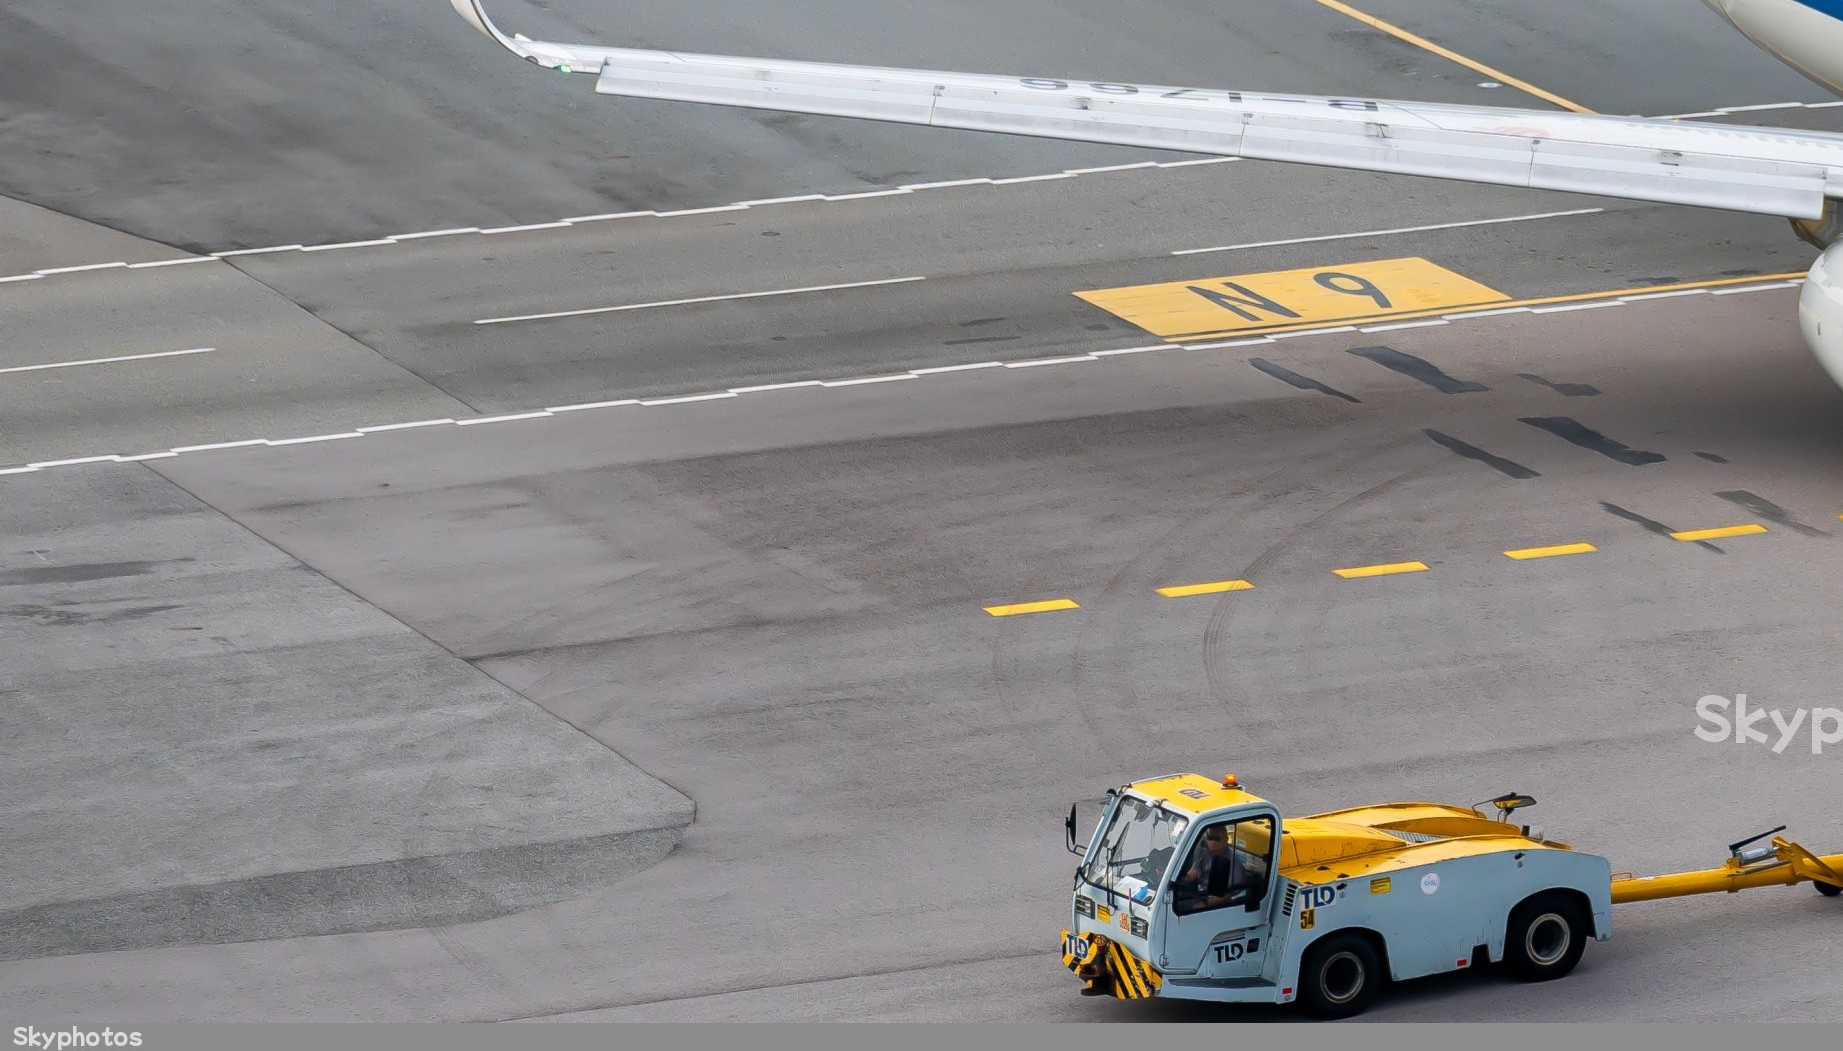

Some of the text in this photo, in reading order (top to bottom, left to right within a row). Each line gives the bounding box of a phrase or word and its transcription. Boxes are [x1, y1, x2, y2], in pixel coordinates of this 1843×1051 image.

[1301, 885, 1336, 909] TLD
[1300, 910, 1315, 930] 54
[1066, 933, 1090, 959] TLD
[1214, 943, 1244, 964] TLD
